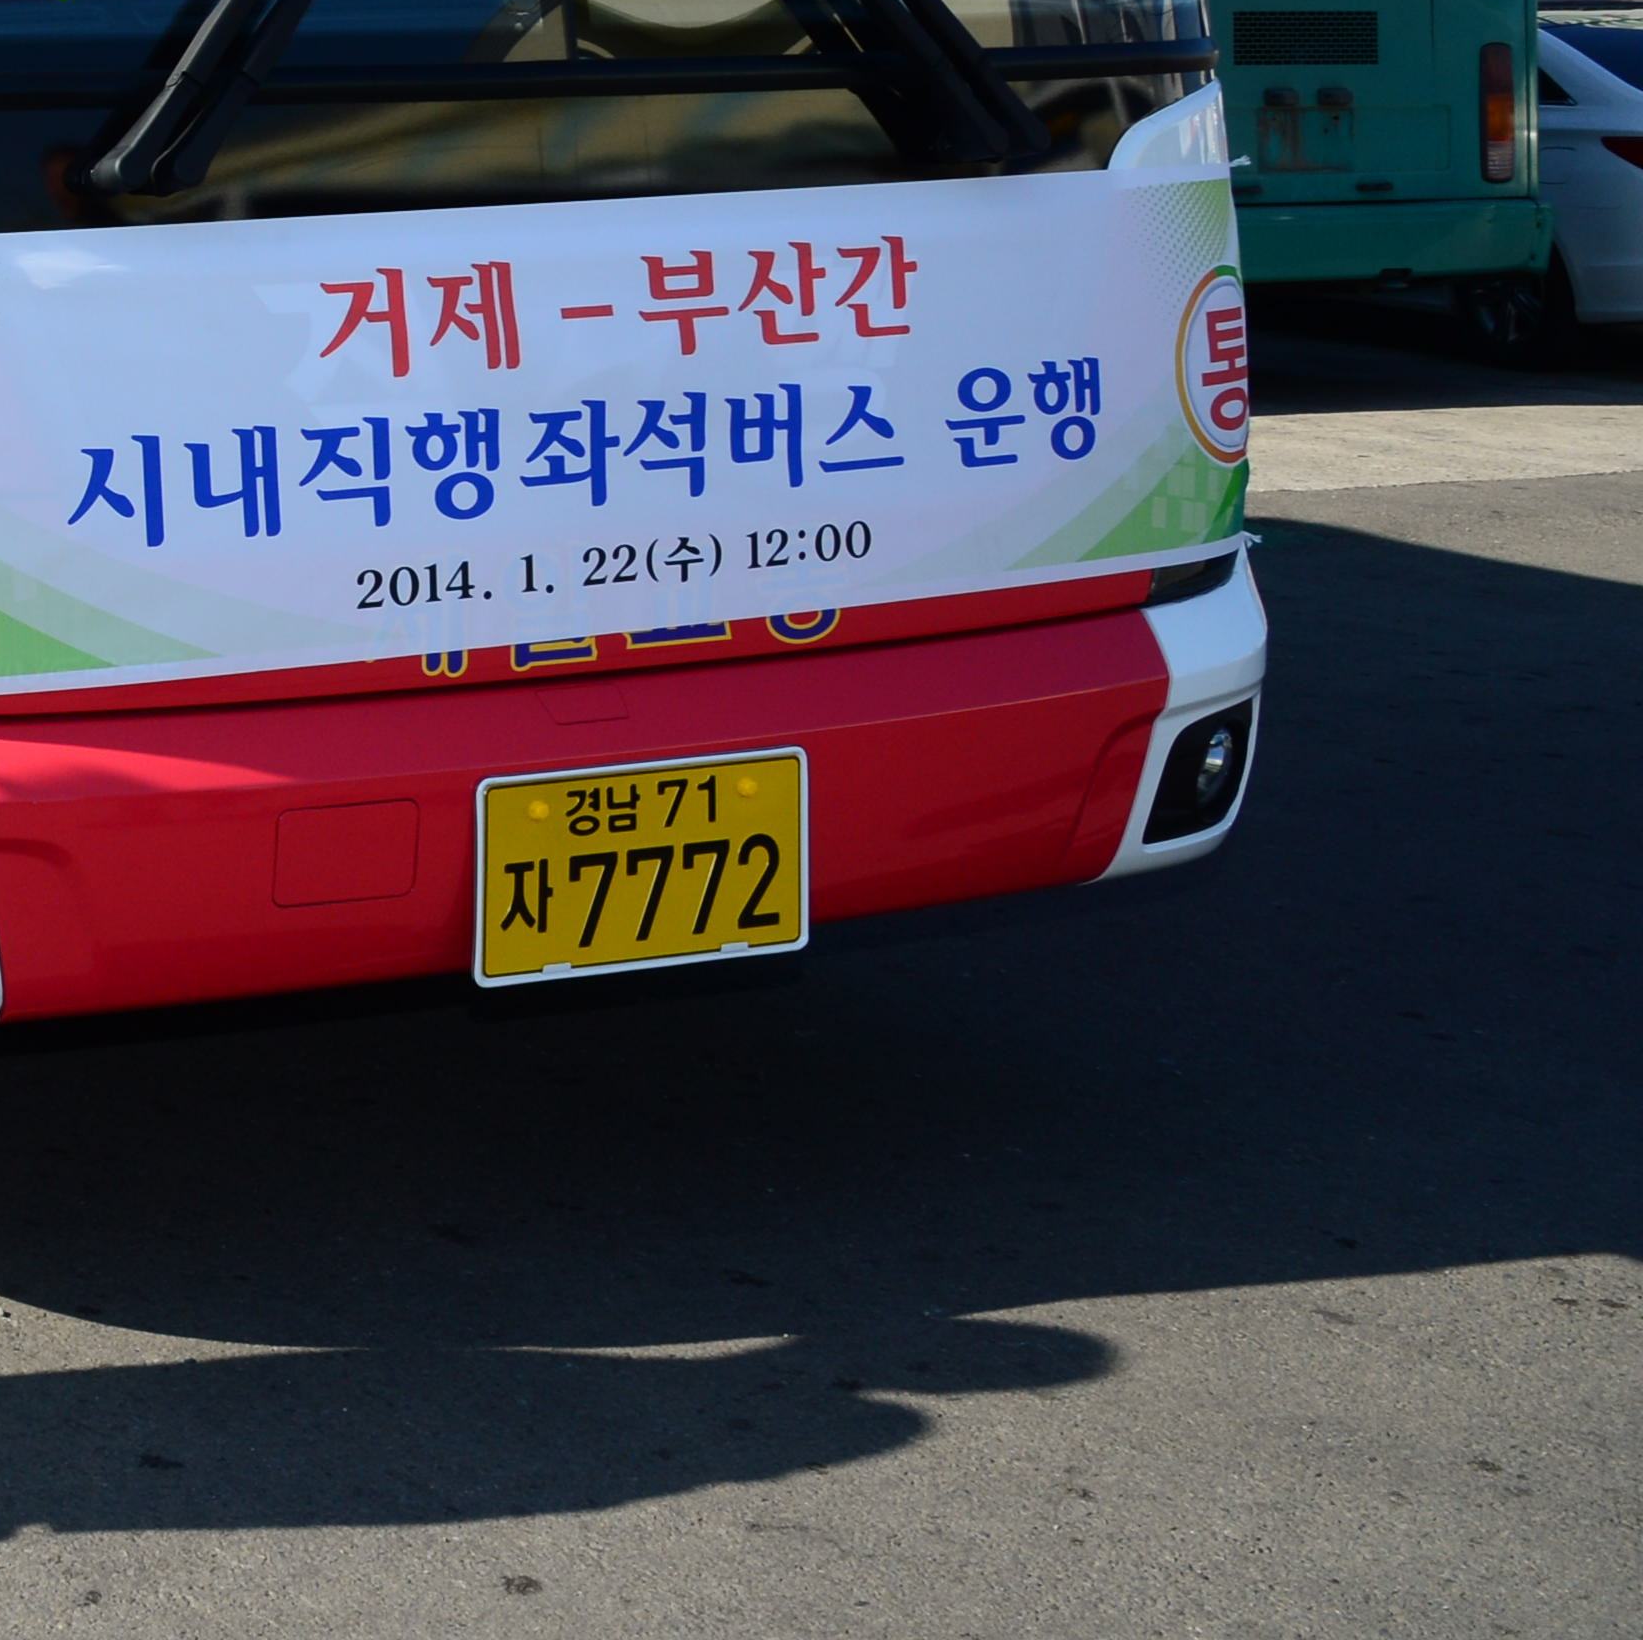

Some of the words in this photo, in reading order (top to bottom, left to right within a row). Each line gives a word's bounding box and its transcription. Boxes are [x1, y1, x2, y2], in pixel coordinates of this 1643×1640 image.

[318, 260, 522, 378] 거제
[638, 234, 919, 357] 부산간
[1199, 303, 1250, 432] 통
[66, 383, 905, 548] 시내직행좌석버스
[945, 356, 1102, 469] 운행
[356, 559, 493, 611] 2014.
[581, 532, 724, 587] 22(수)
[745, 520, 872, 570] 12:00
[565, 782, 640, 837] 경남
[657, 775, 717, 828] 71
